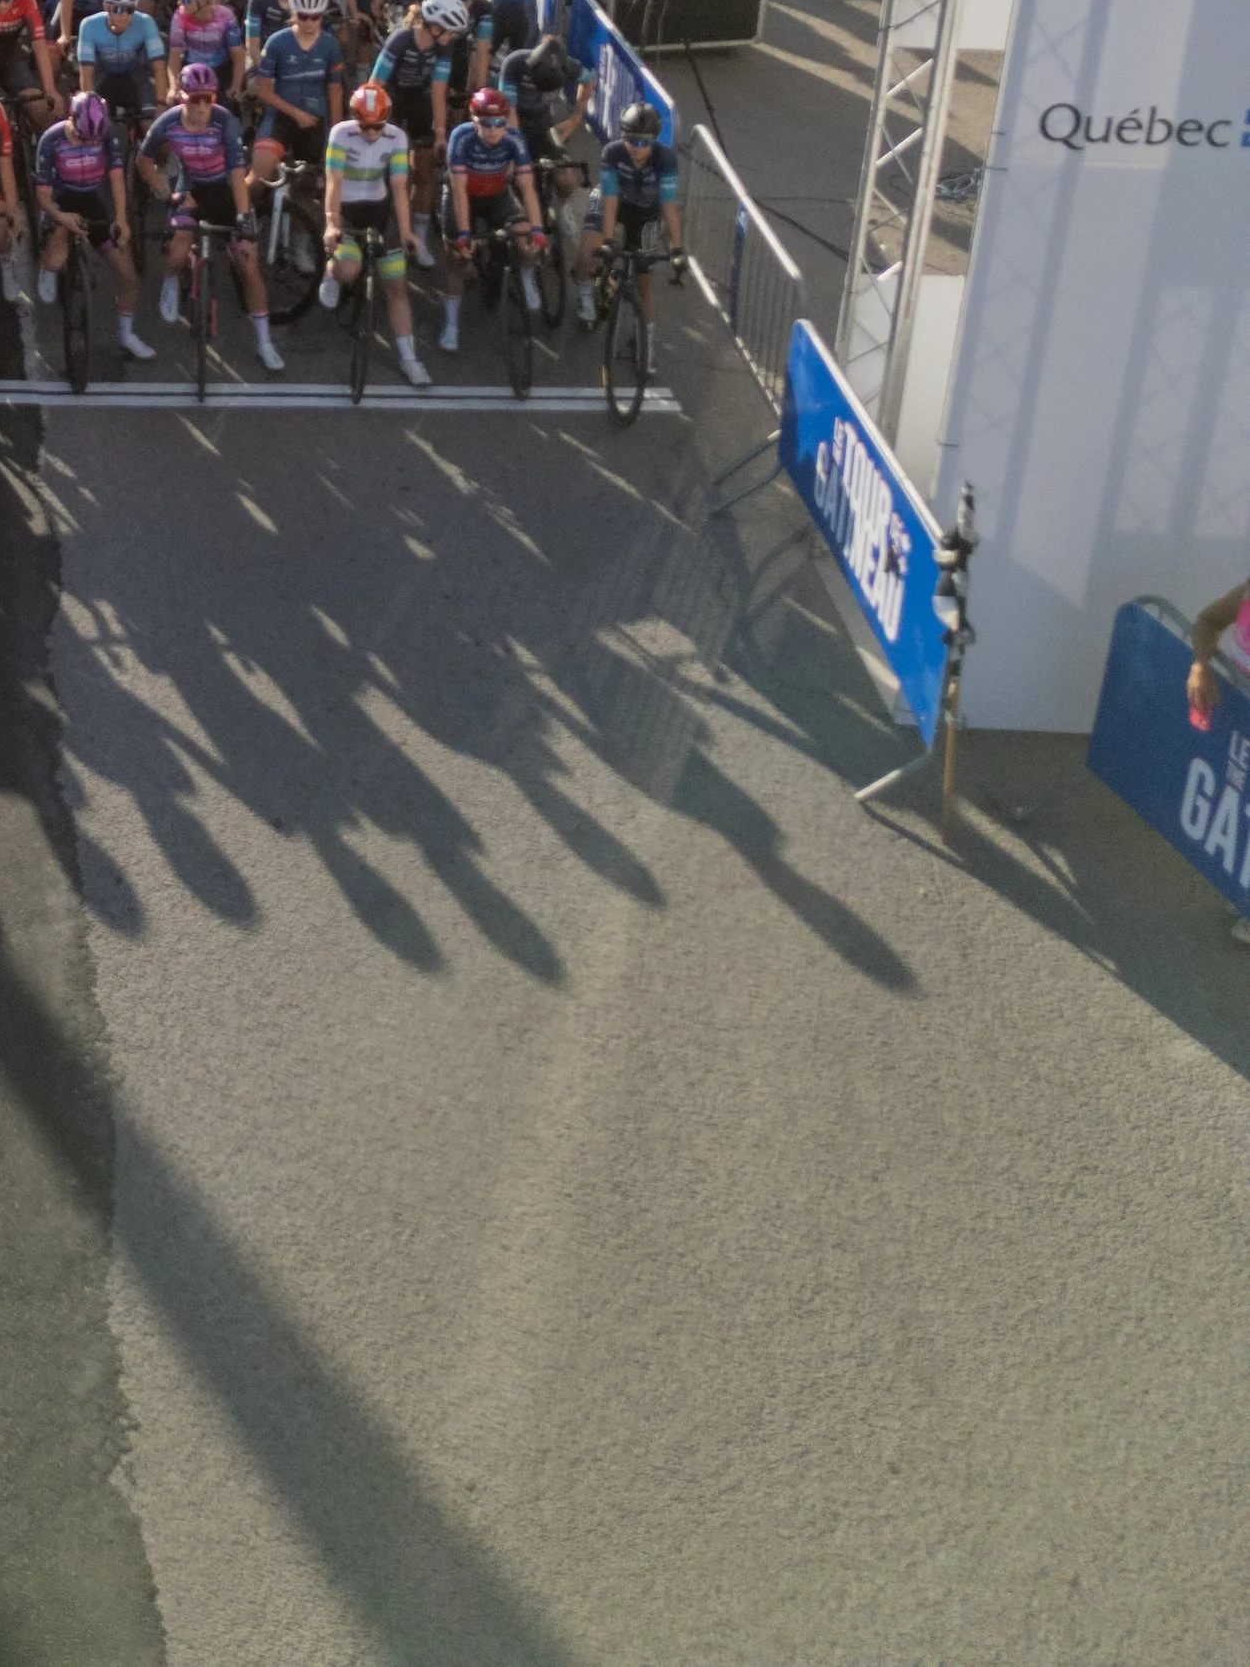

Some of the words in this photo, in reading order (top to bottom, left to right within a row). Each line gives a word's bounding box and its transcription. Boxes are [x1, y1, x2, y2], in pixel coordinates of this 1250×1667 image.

[1039, 102, 1235, 151] Québec
[813, 440, 905, 643] GATINEAU
[843, 421, 893, 549] TOUR
